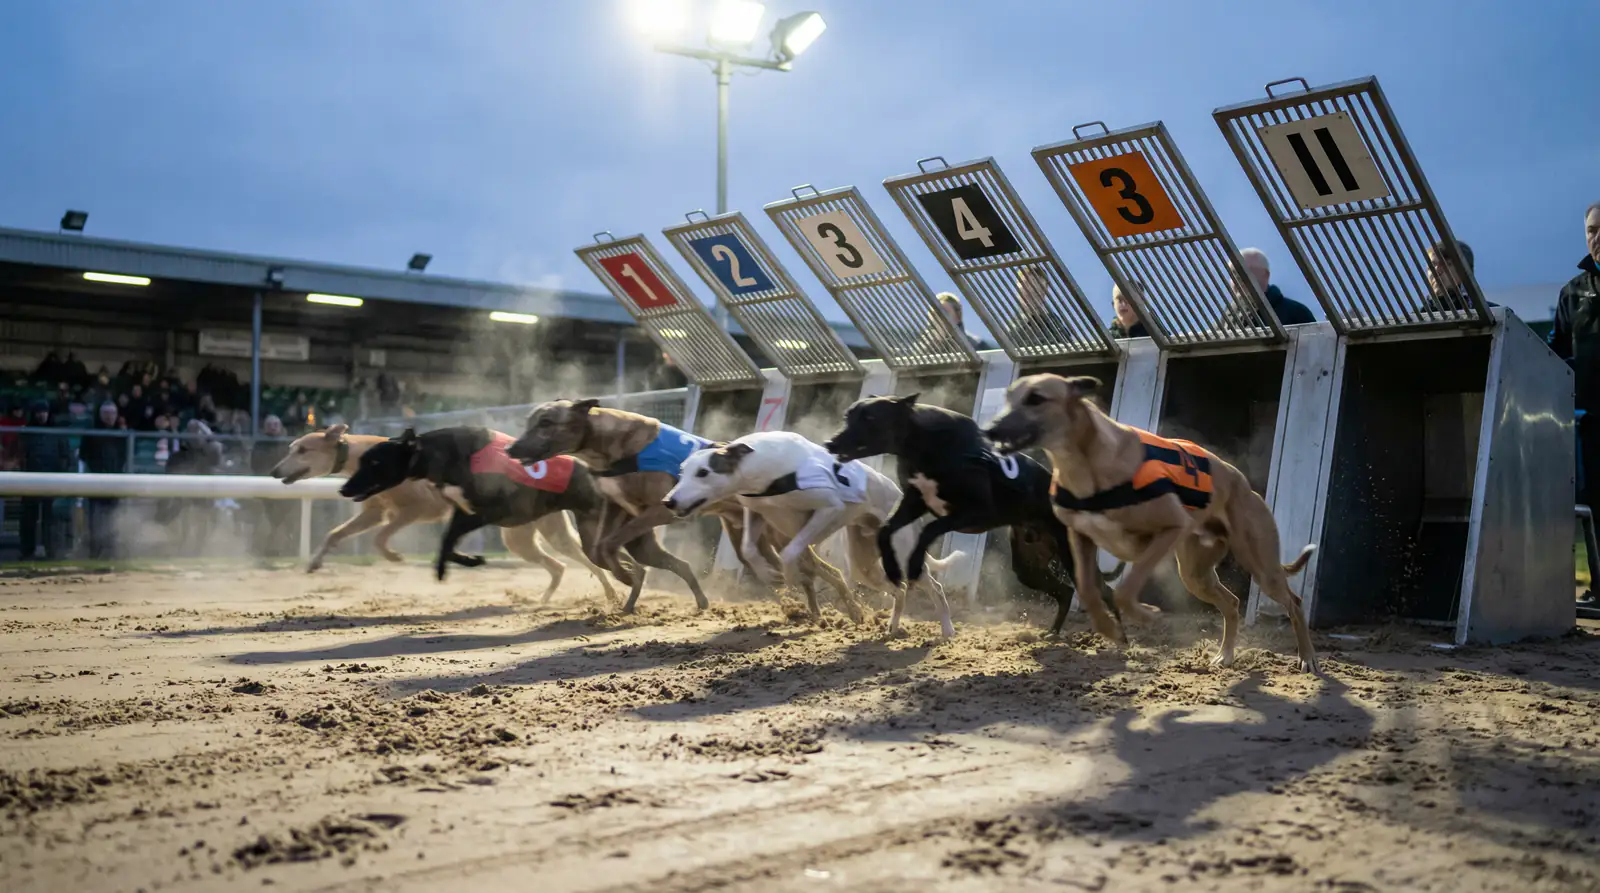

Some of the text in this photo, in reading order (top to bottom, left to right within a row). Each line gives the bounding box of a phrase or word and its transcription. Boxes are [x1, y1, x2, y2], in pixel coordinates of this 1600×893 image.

[1099, 167, 1154, 225] 3
[954, 197, 994, 248] 4
[711, 244, 757, 287] 2
[817, 222, 863, 268] 3
[620, 263, 657, 300] 1
[762, 398, 783, 432] 7
